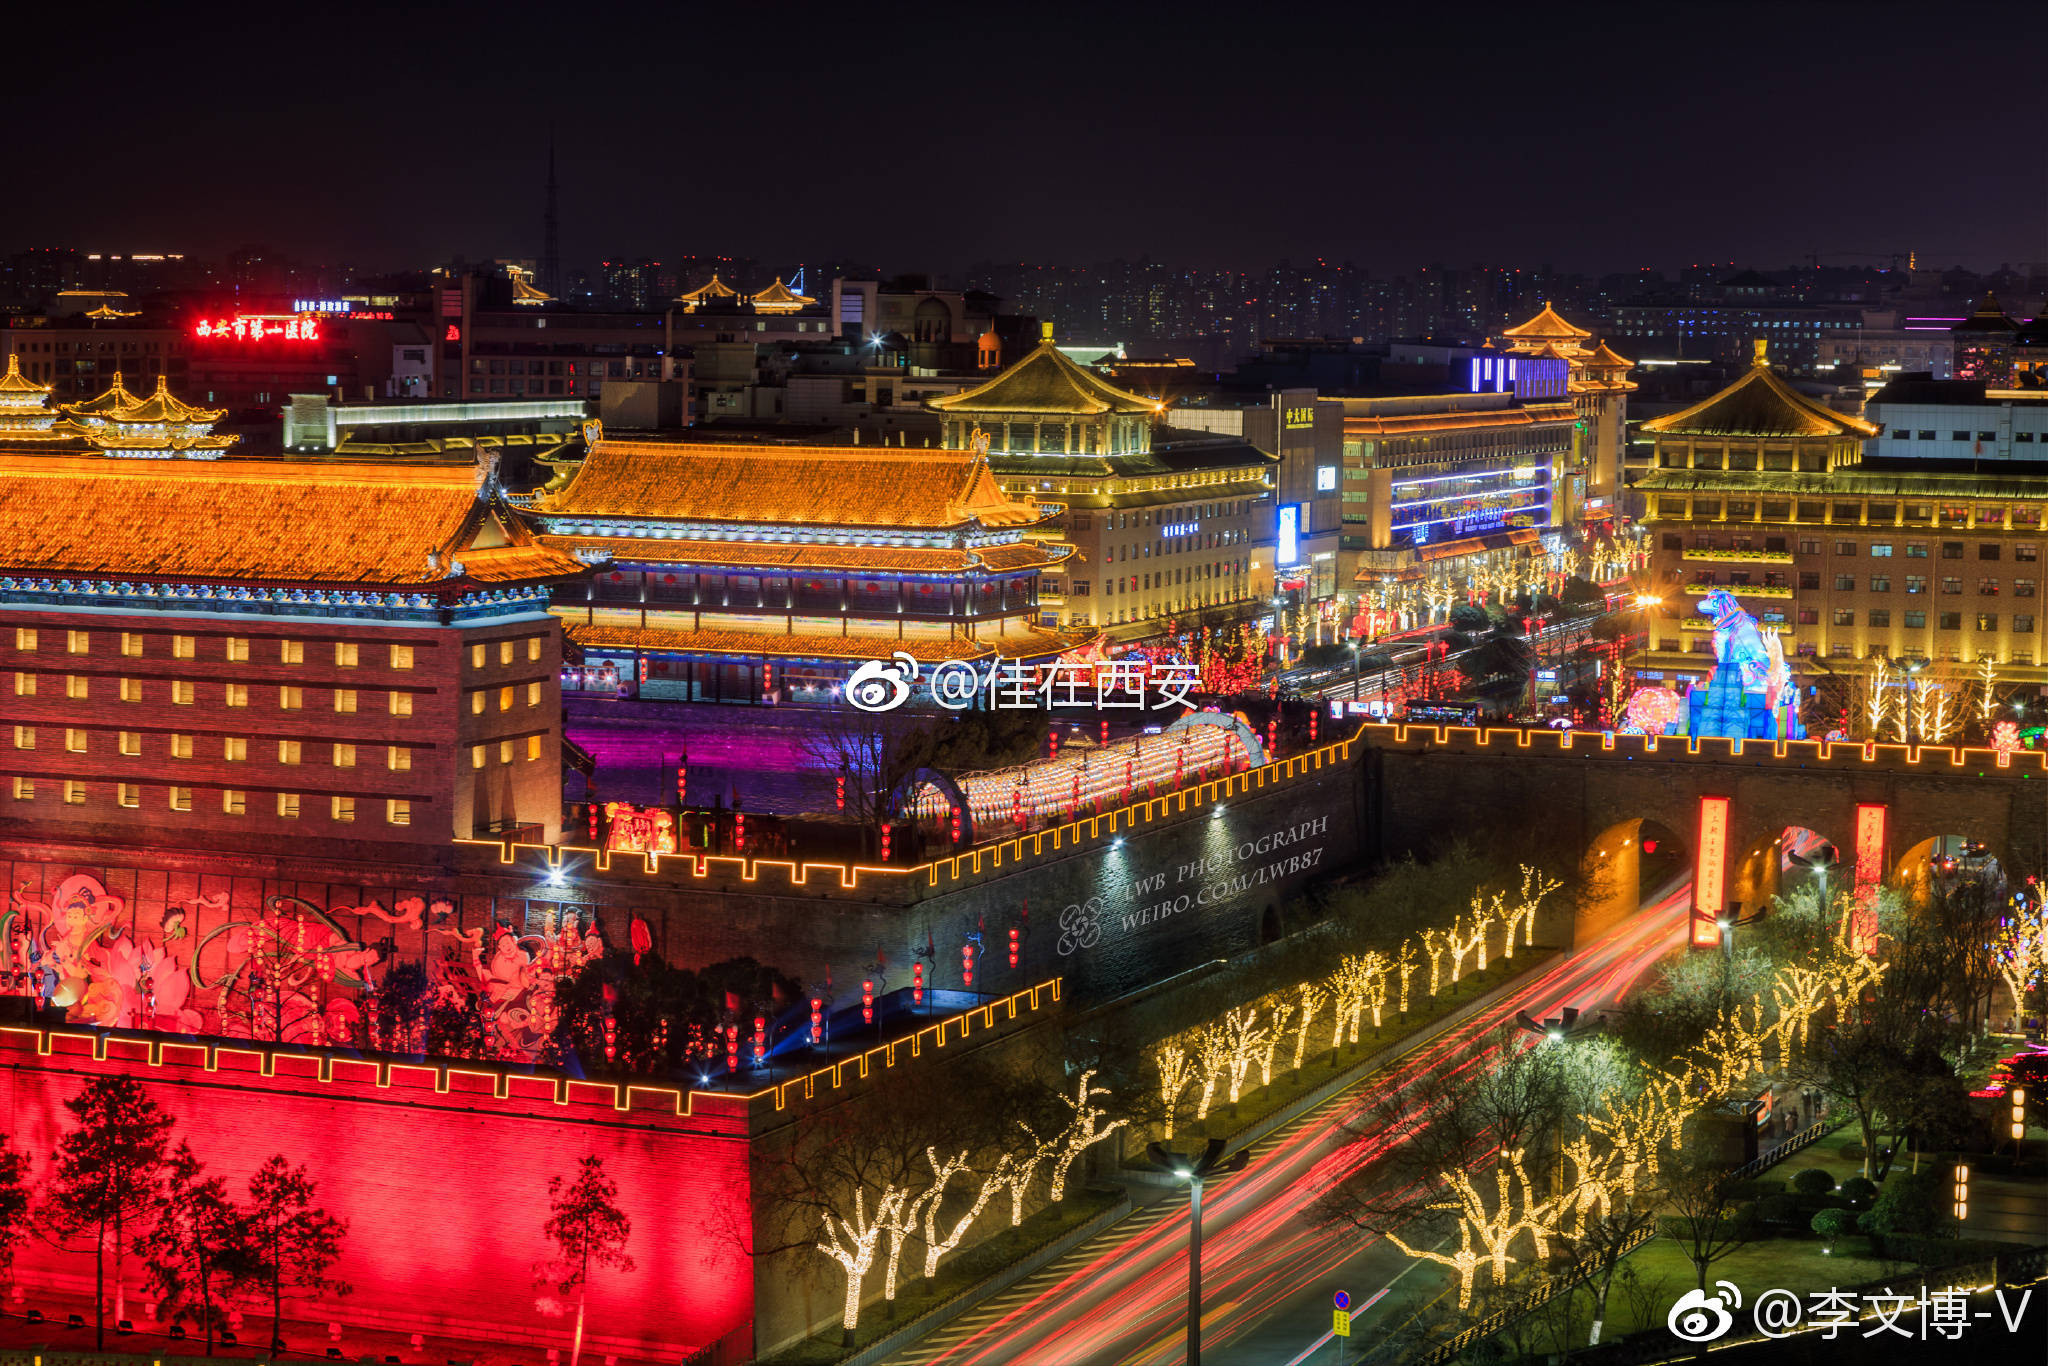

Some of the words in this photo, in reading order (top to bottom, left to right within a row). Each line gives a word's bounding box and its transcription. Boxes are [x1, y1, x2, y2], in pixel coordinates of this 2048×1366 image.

[196, 317, 319, 342] 西安市第一医院
[1286, 408, 1314, 424] 中大国际
